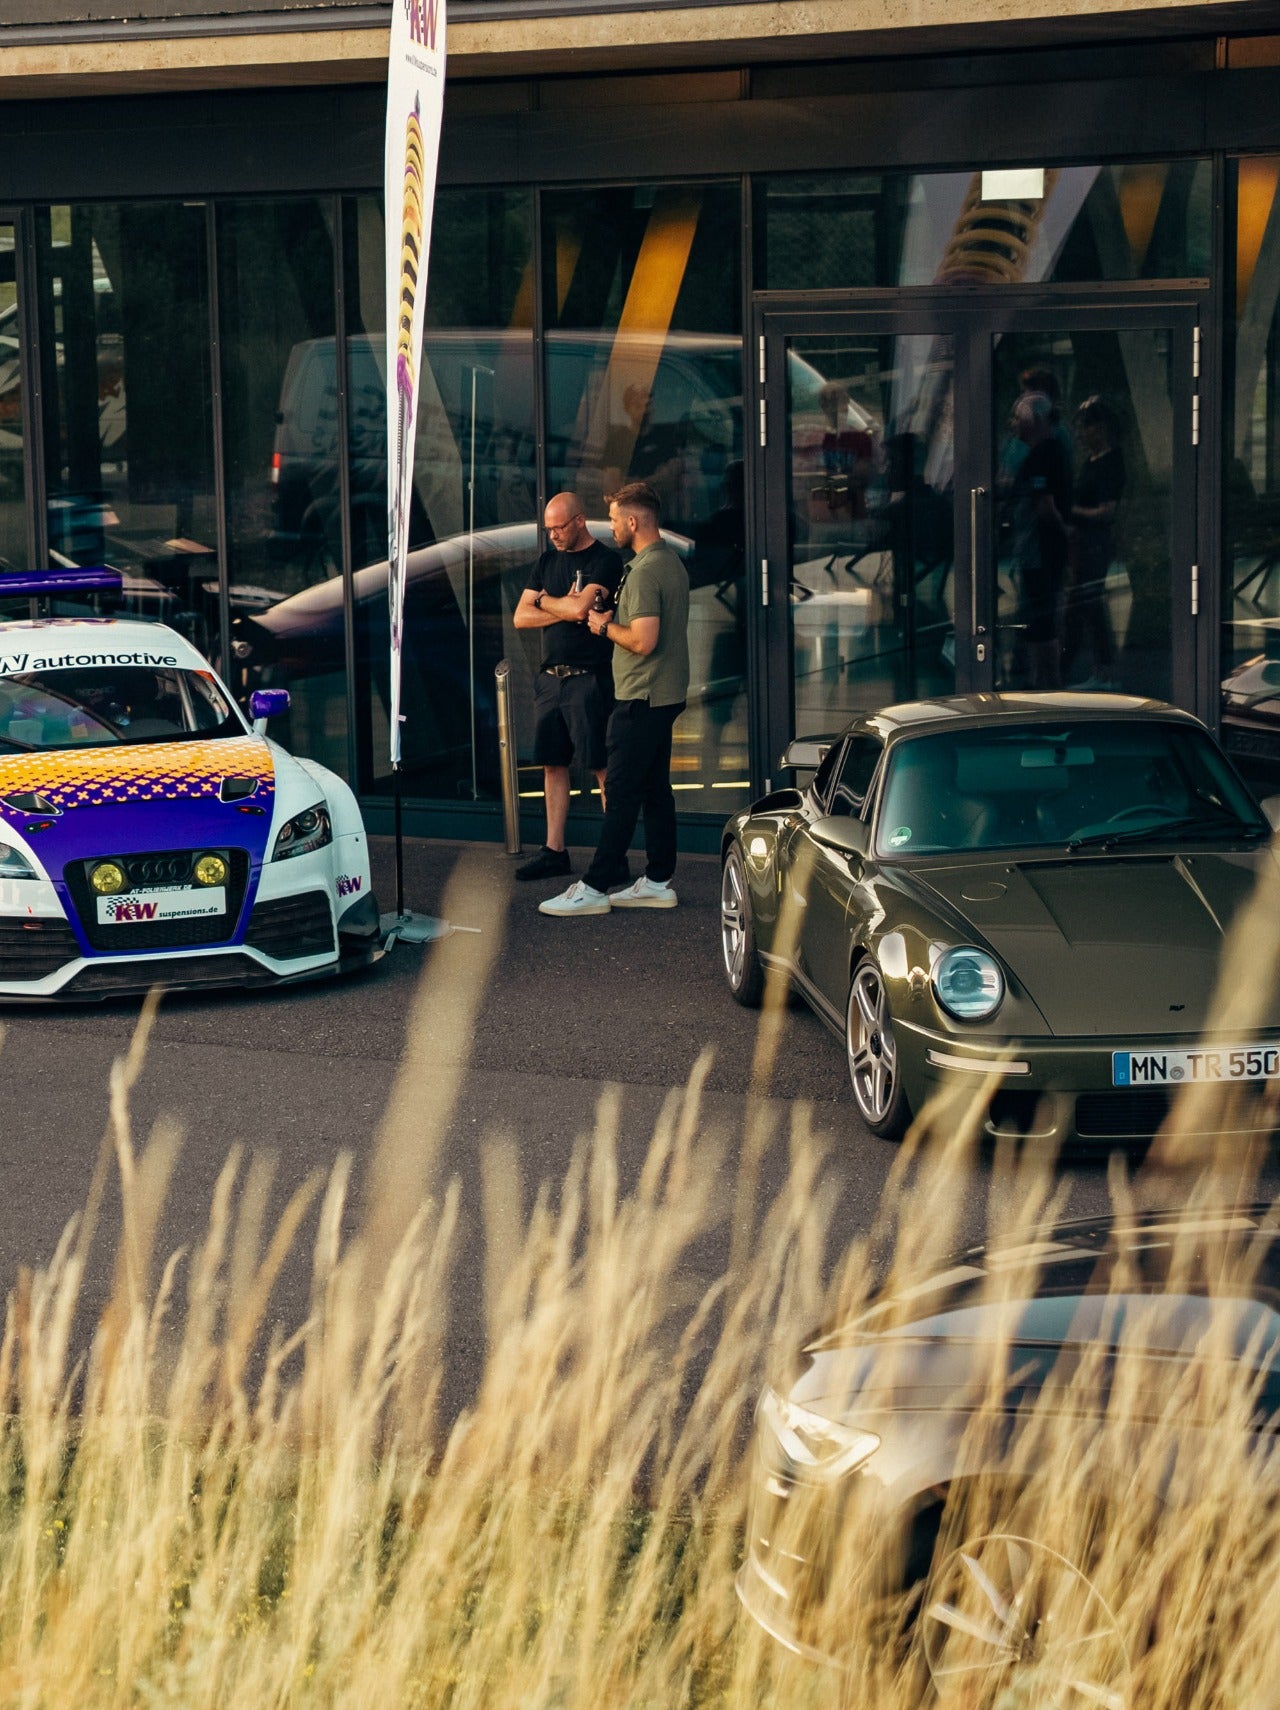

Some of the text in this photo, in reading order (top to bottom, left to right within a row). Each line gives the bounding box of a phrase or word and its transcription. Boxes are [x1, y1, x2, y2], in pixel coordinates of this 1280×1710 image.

[32, 652, 178, 670] automotive
[115, 902, 219, 922] KW suspensions.de
[1131, 1050, 1280, 1081] MN TR 550
